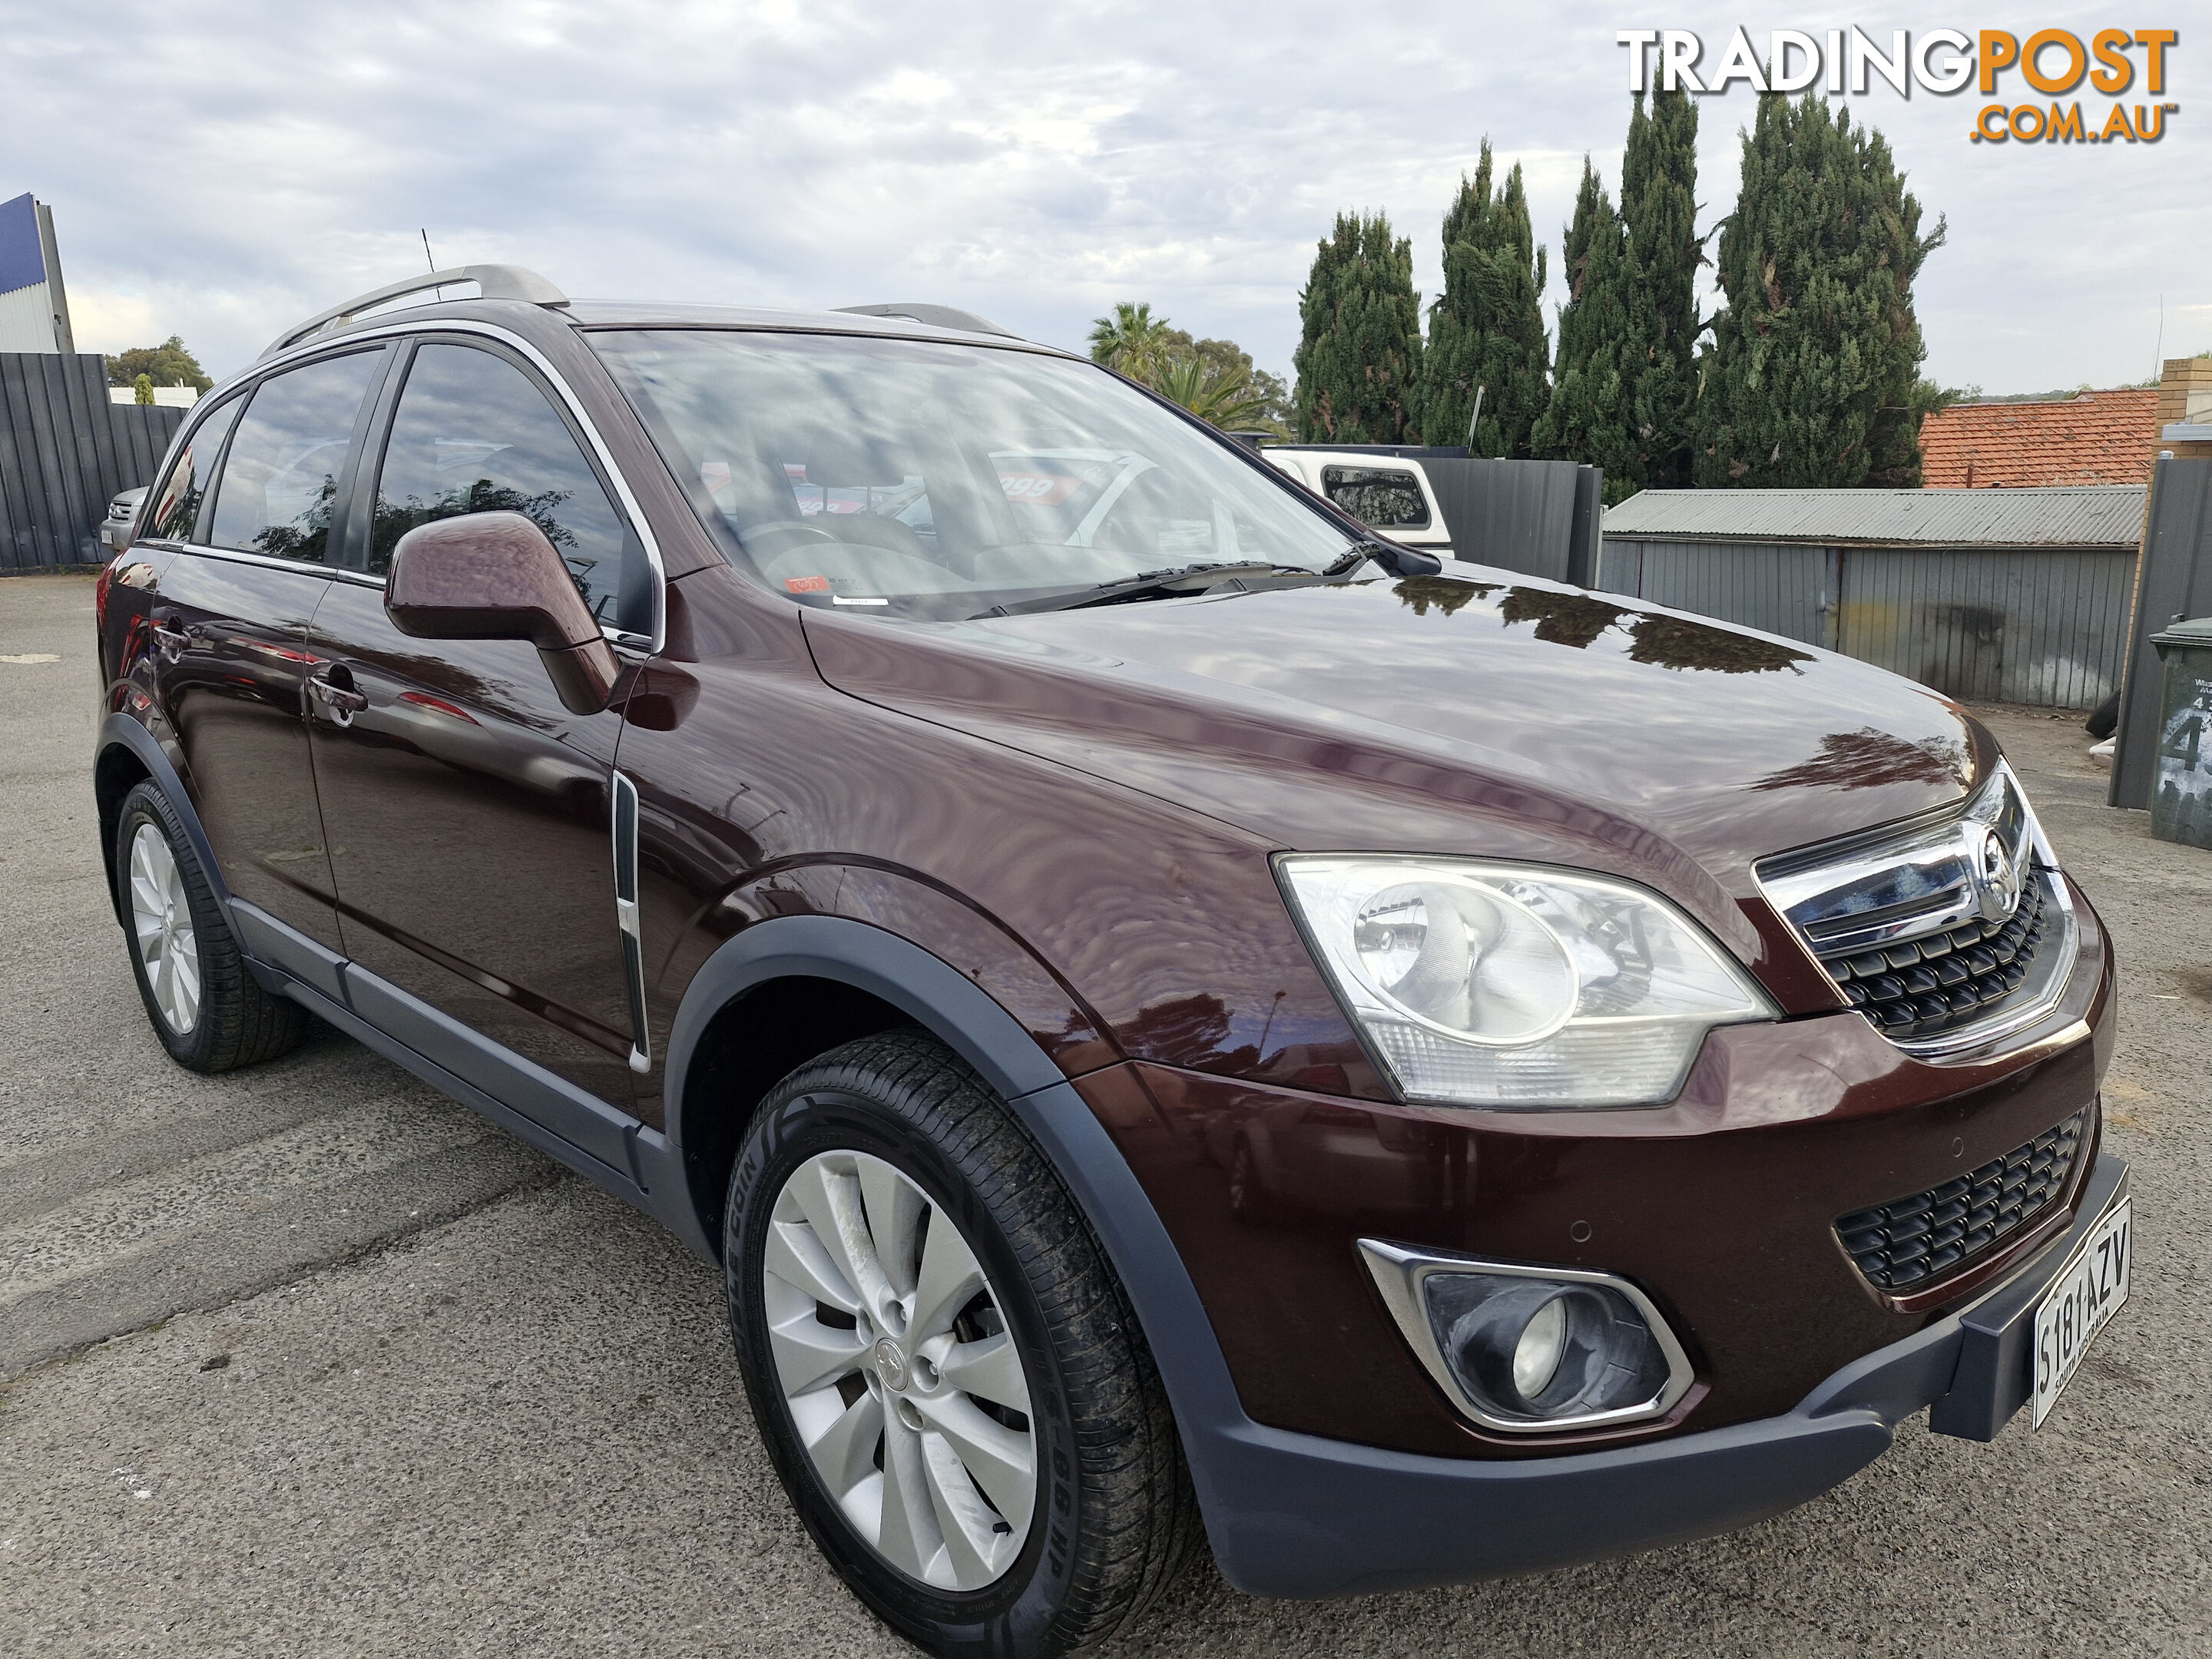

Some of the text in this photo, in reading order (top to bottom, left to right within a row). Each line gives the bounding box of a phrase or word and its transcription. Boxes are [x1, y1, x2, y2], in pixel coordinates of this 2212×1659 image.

[730, 1152, 758, 1238] COIN
[2055, 1306, 2109, 1395] SOUTH AUSTRALIA
